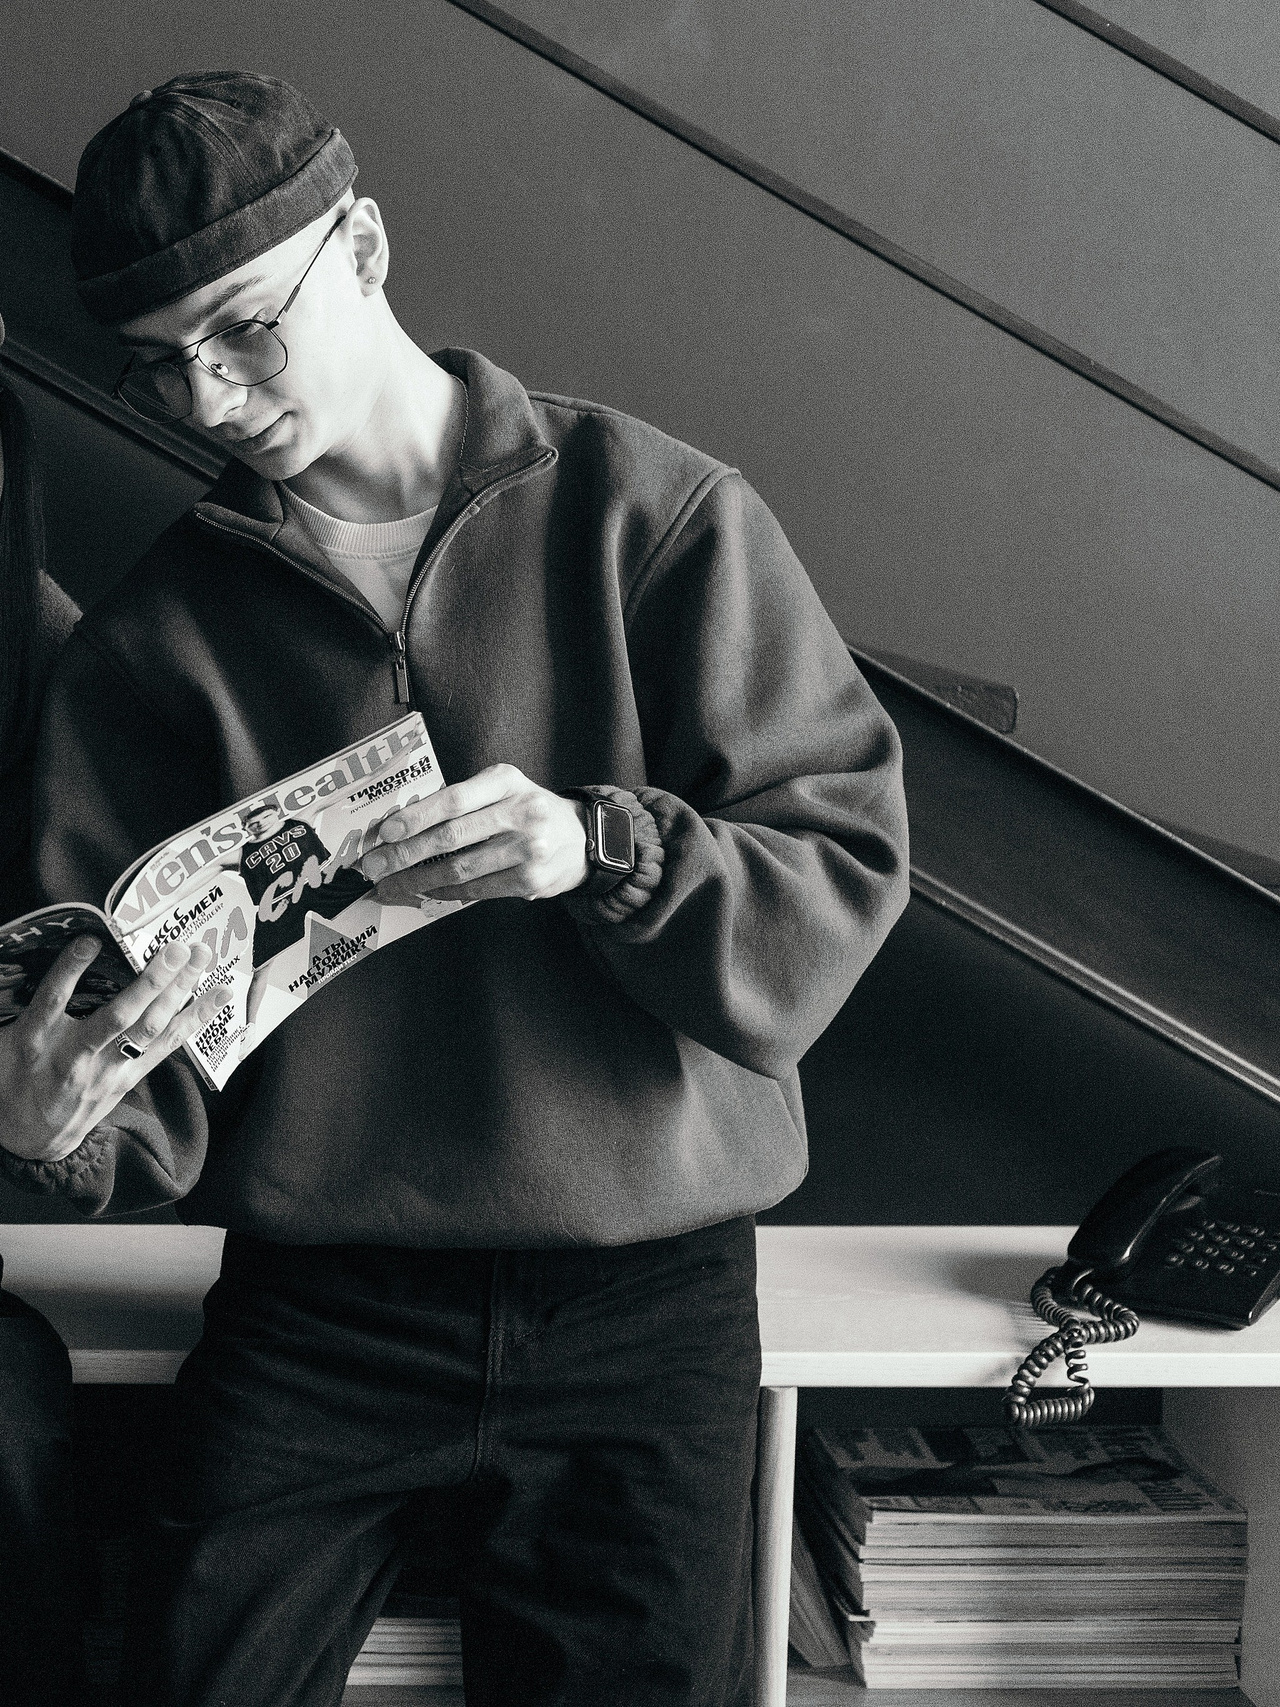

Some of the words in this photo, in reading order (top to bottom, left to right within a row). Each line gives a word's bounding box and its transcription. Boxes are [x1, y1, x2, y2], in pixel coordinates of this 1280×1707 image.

[347, 755, 430, 803] ТИМОФЕЙ
[366, 763, 432, 801] МОЗГОВ
[118, 821, 248, 947] Men's
[233, 728, 428, 840] Health
[245, 824, 307, 870] CAVS
[265, 841, 302, 875] 20
[142, 919, 173, 963] СЕКС
[173, 907, 184, 921] С
[312, 955, 322, 966] А
[322, 937, 347, 956] ТЫ
[288, 924, 378, 993] НАСТОЯЩИЙ
[304, 941, 367, 989] МУЖИК?
[195, 1004, 235, 1048] НИКТО,
[199, 1011, 235, 1054] КРОМЕ
[202, 1027, 228, 1058] ТЕБЯ
